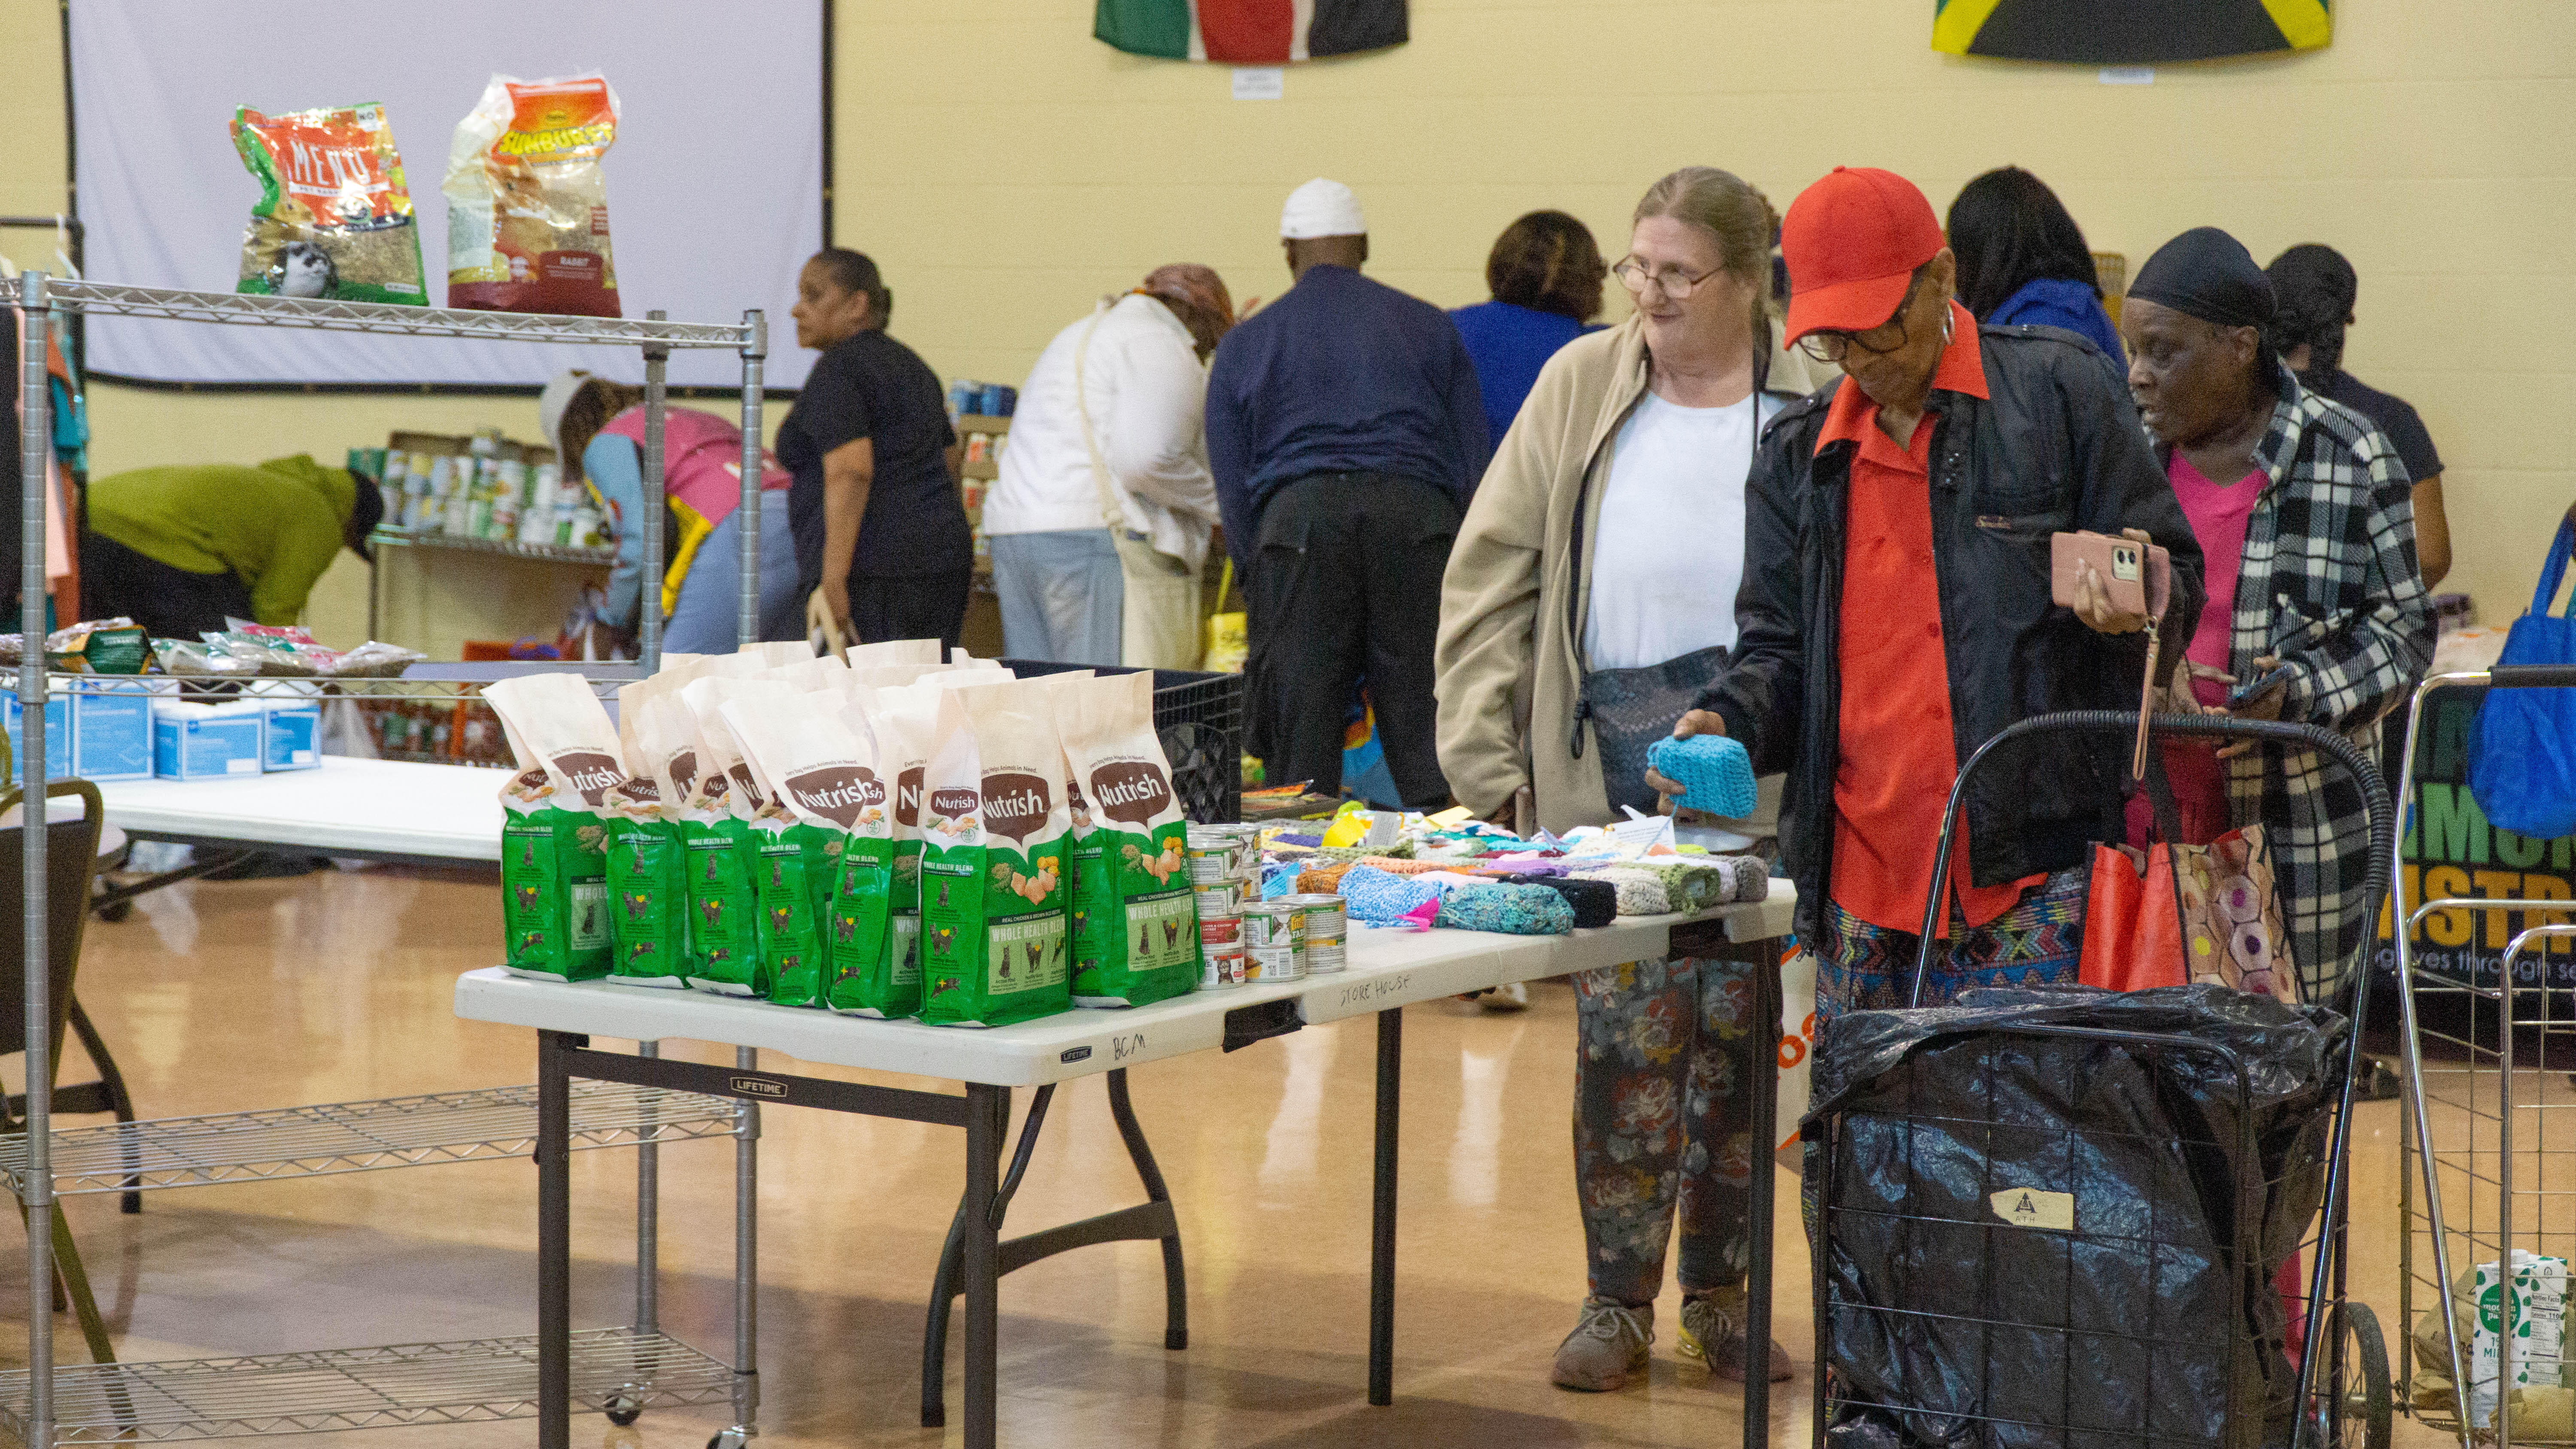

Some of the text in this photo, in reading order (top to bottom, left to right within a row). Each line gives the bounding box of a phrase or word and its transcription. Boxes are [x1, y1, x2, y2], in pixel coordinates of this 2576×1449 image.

[498, 122, 613, 155] SUNBURST
[289, 140, 371, 187] MENU
[570, 766, 622, 791] utrish
[625, 781, 660, 796] Nutris
[982, 788, 1043, 819] Nutrish
[1128, 904, 1157, 921] WHOLE
[992, 926, 1021, 942] WHOLE
[1024, 922, 1048, 939] HEALTH
[1340, 982, 1370, 1006] STORE
[1063, 1049, 1089, 1061] LIFETIME
[737, 1080, 781, 1094] LIFETIME
